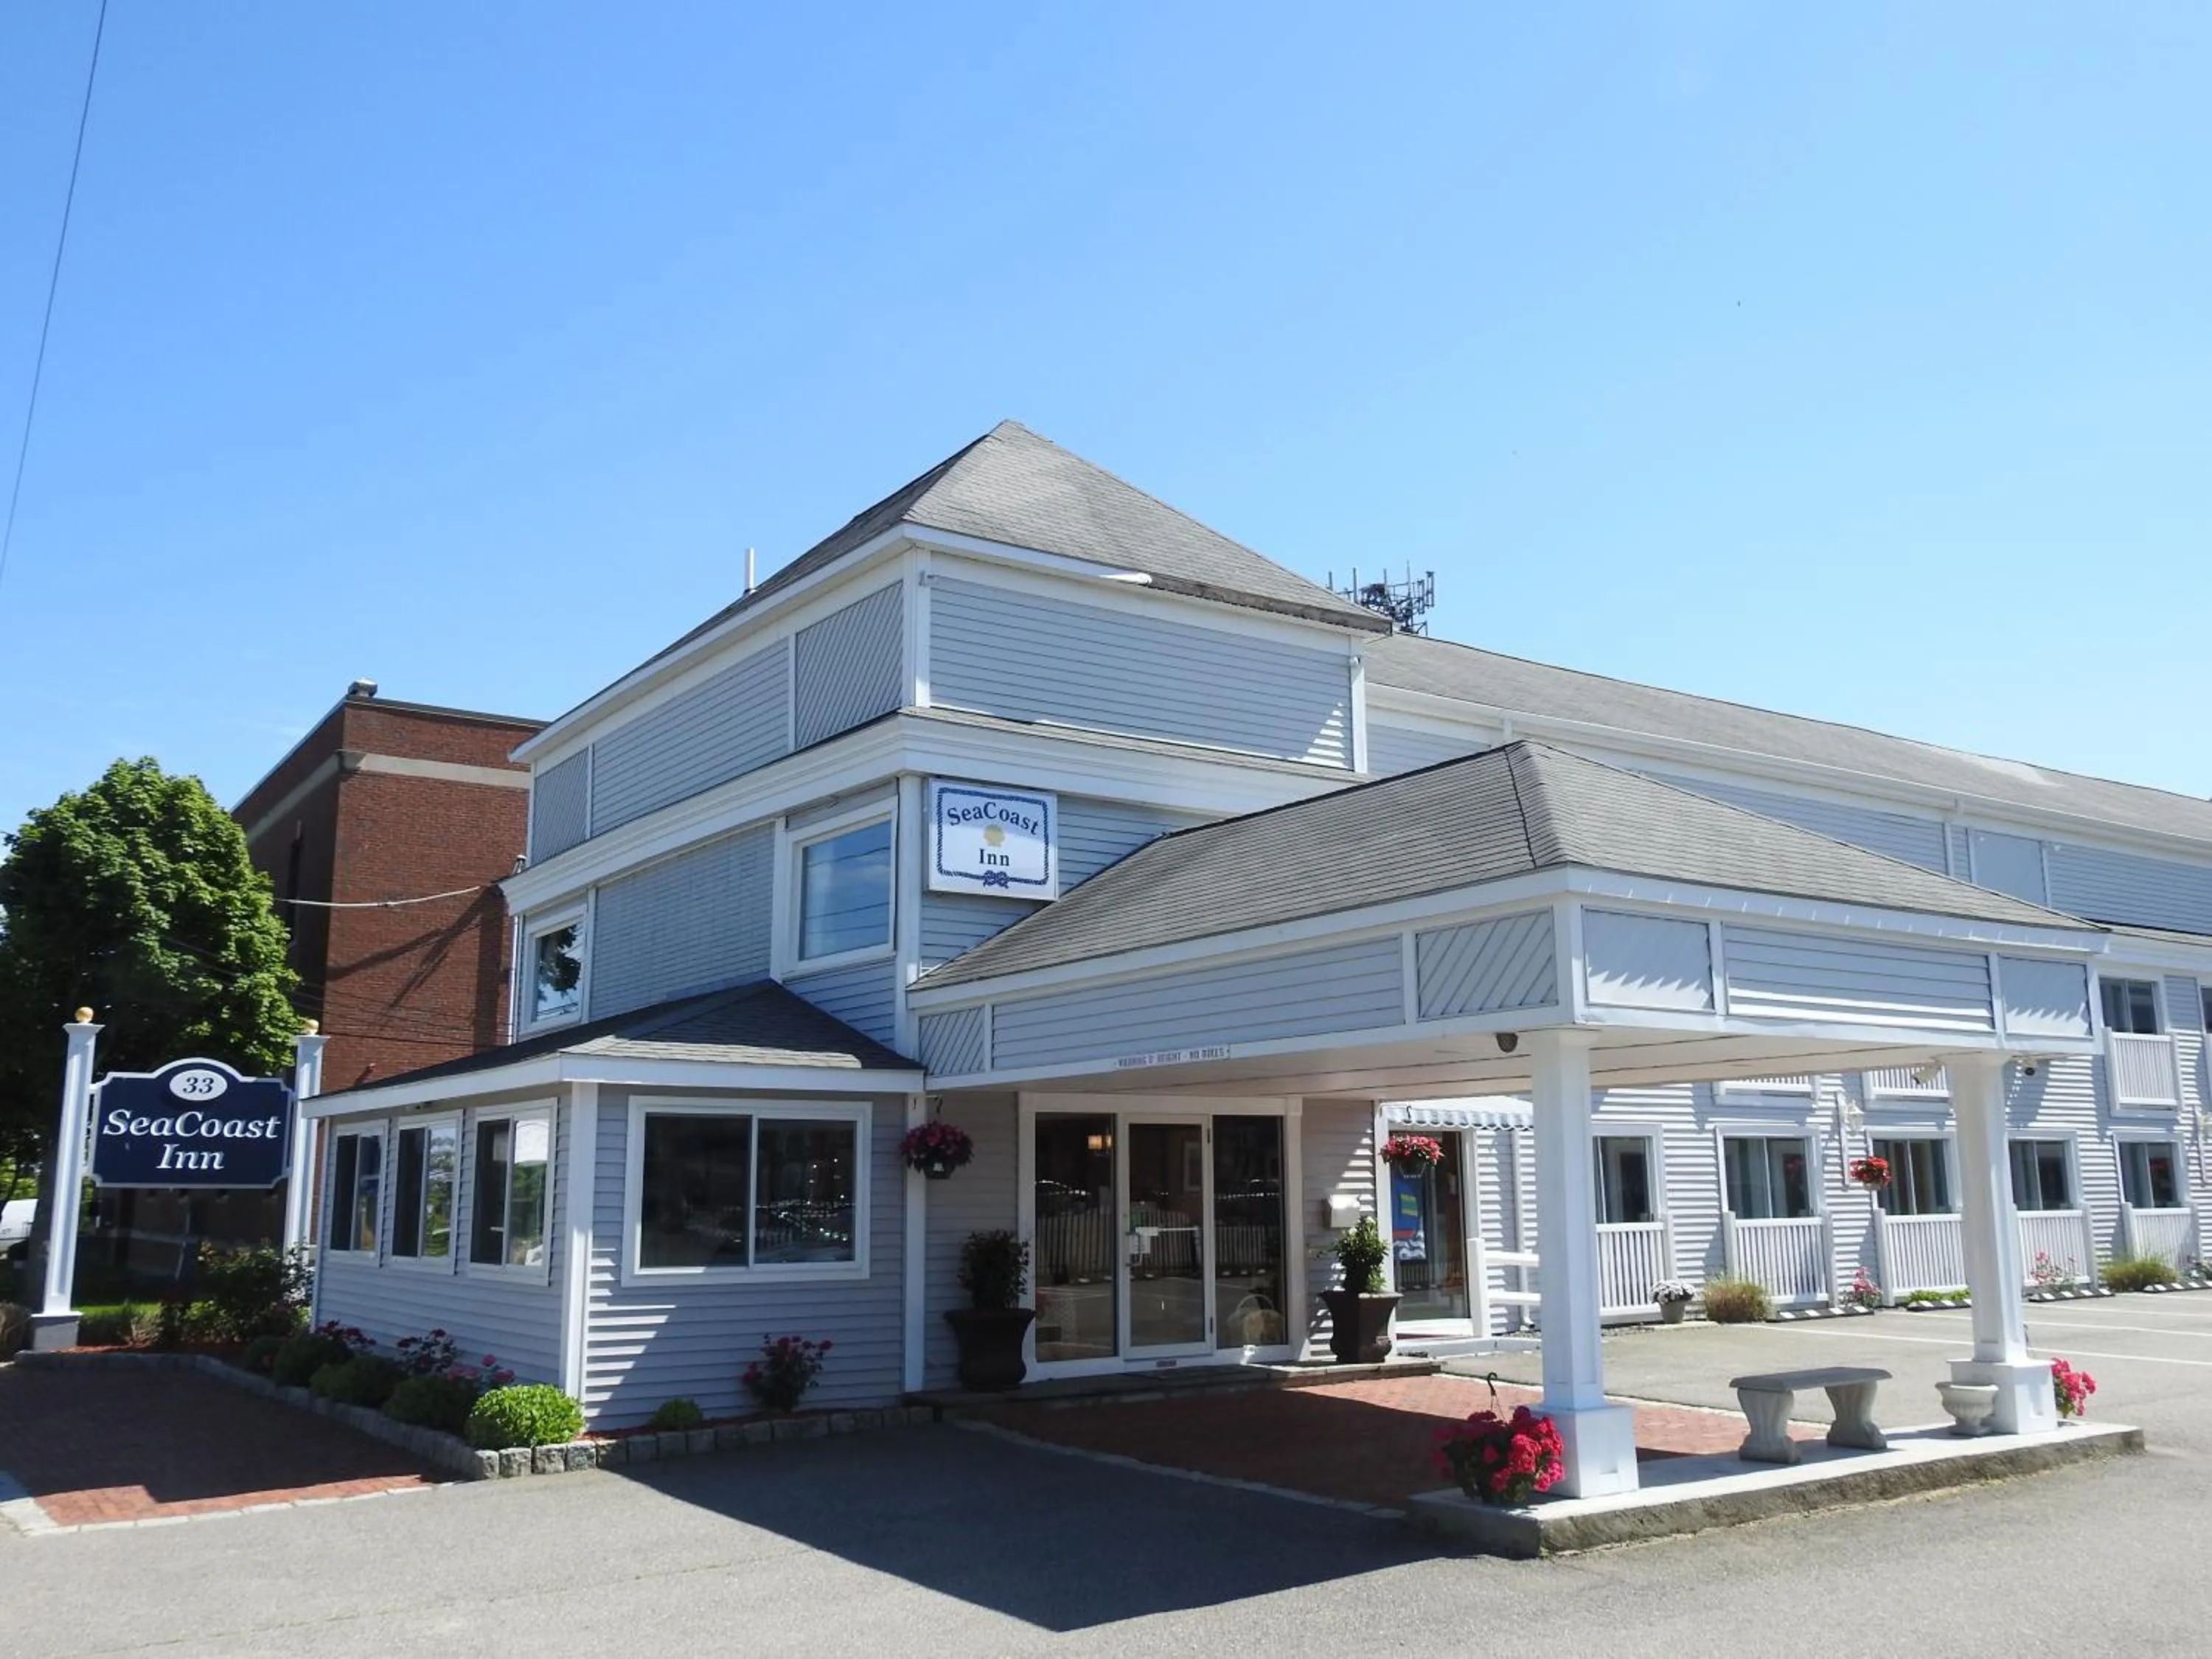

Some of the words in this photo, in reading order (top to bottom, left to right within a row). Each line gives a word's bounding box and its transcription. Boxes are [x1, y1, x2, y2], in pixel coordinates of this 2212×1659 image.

[947, 801, 1039, 835] SeaCoast
[978, 848, 1010, 866] Inn
[182, 1077, 215, 1093] 33
[102, 1109, 280, 1138] SeaCoast
[155, 1144, 224, 1169] Inn
